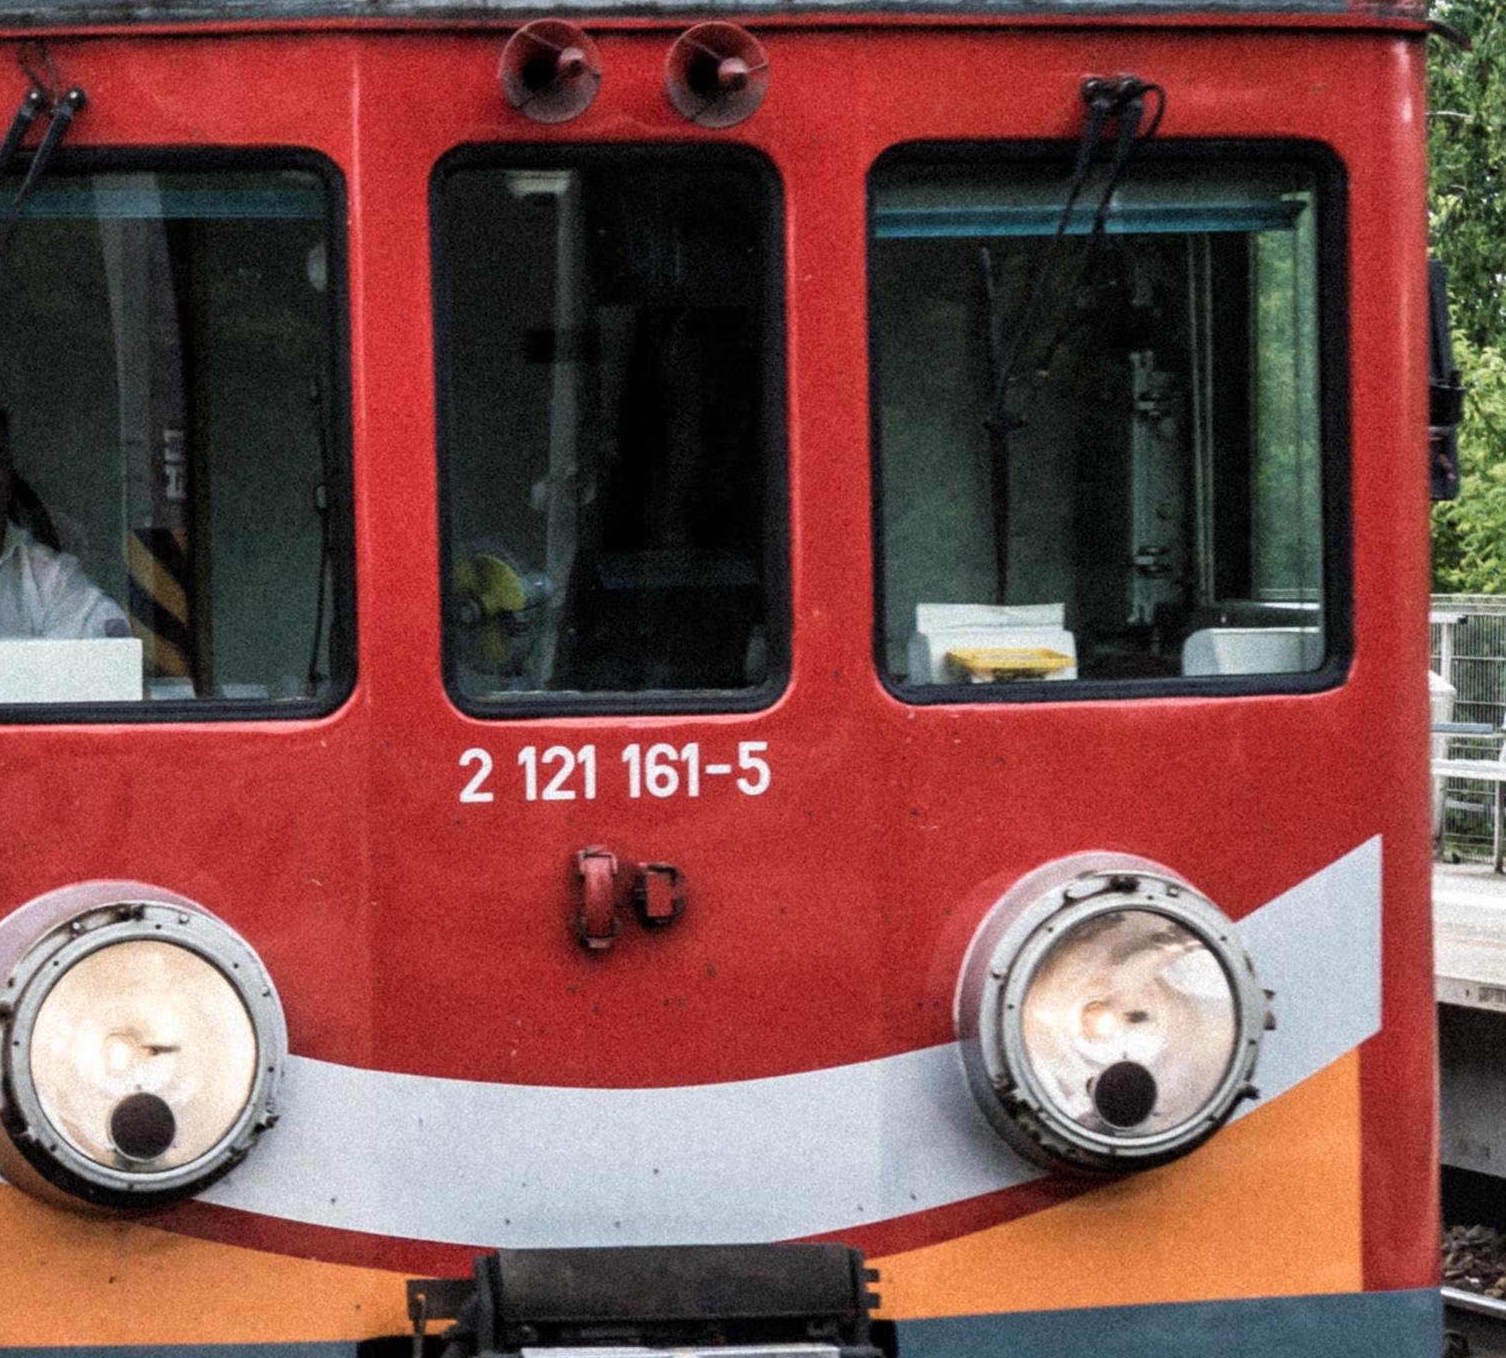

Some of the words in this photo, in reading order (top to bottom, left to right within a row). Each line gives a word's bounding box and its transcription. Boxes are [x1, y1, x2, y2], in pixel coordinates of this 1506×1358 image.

[458, 747, 495, 803] 2
[517, 744, 597, 801] 121
[622, 740, 771, 799] 161-5
